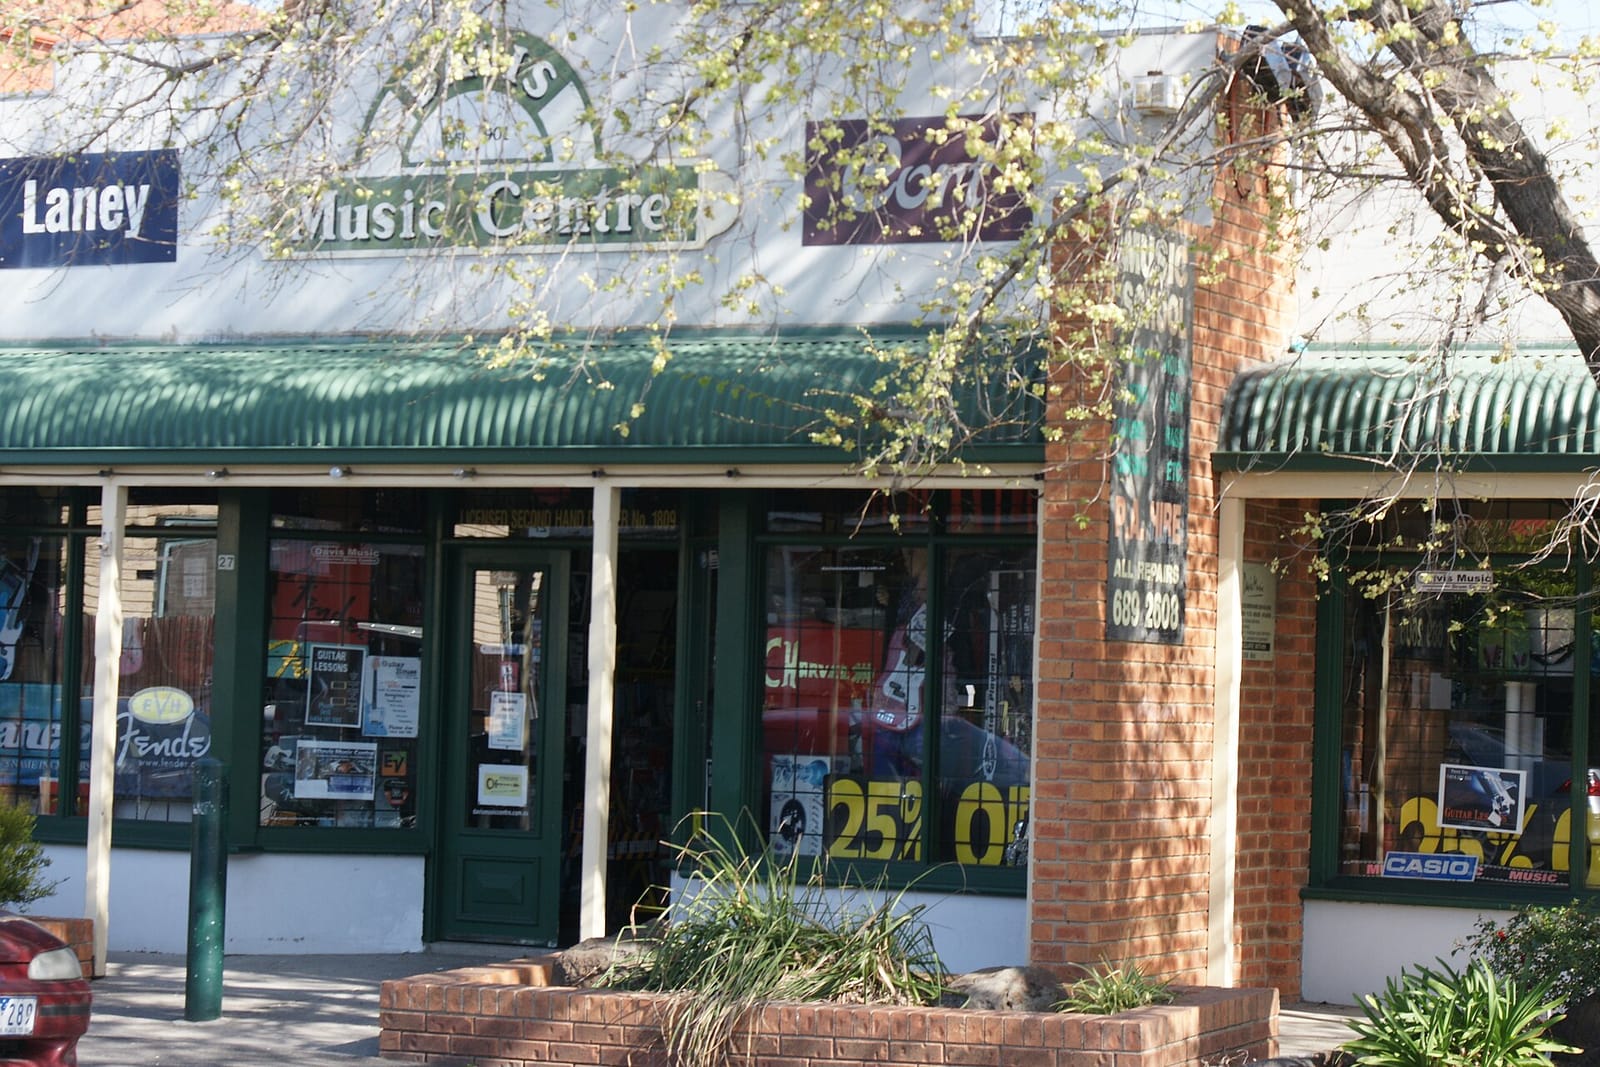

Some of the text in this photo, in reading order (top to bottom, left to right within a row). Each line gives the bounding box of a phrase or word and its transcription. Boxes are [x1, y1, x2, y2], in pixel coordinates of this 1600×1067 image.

[23, 180, 150, 239] Laney
[292, 180, 671, 242] Music Centre
[511, 510, 551, 529] SECOND
[555, 510, 584, 528] HAND
[653, 510, 677, 527] 1809
[219, 556, 234, 568] 27
[314, 547, 380, 558] Davis Music
[1113, 558, 1180, 585] ALL REPAIRS
[1457, 573, 1492, 583] Music
[1113, 588, 1180, 631] 689 2608
[317, 650, 347, 662] GUITAR
[313, 661, 349, 673] LESSONS
[141, 690, 183, 717] EVH
[828, 778, 923, 862] 25%
[1386, 856, 1470, 876] CASIO
[1508, 870, 1558, 883] MUSIC
[7, 1003, 33, 1026] 289
